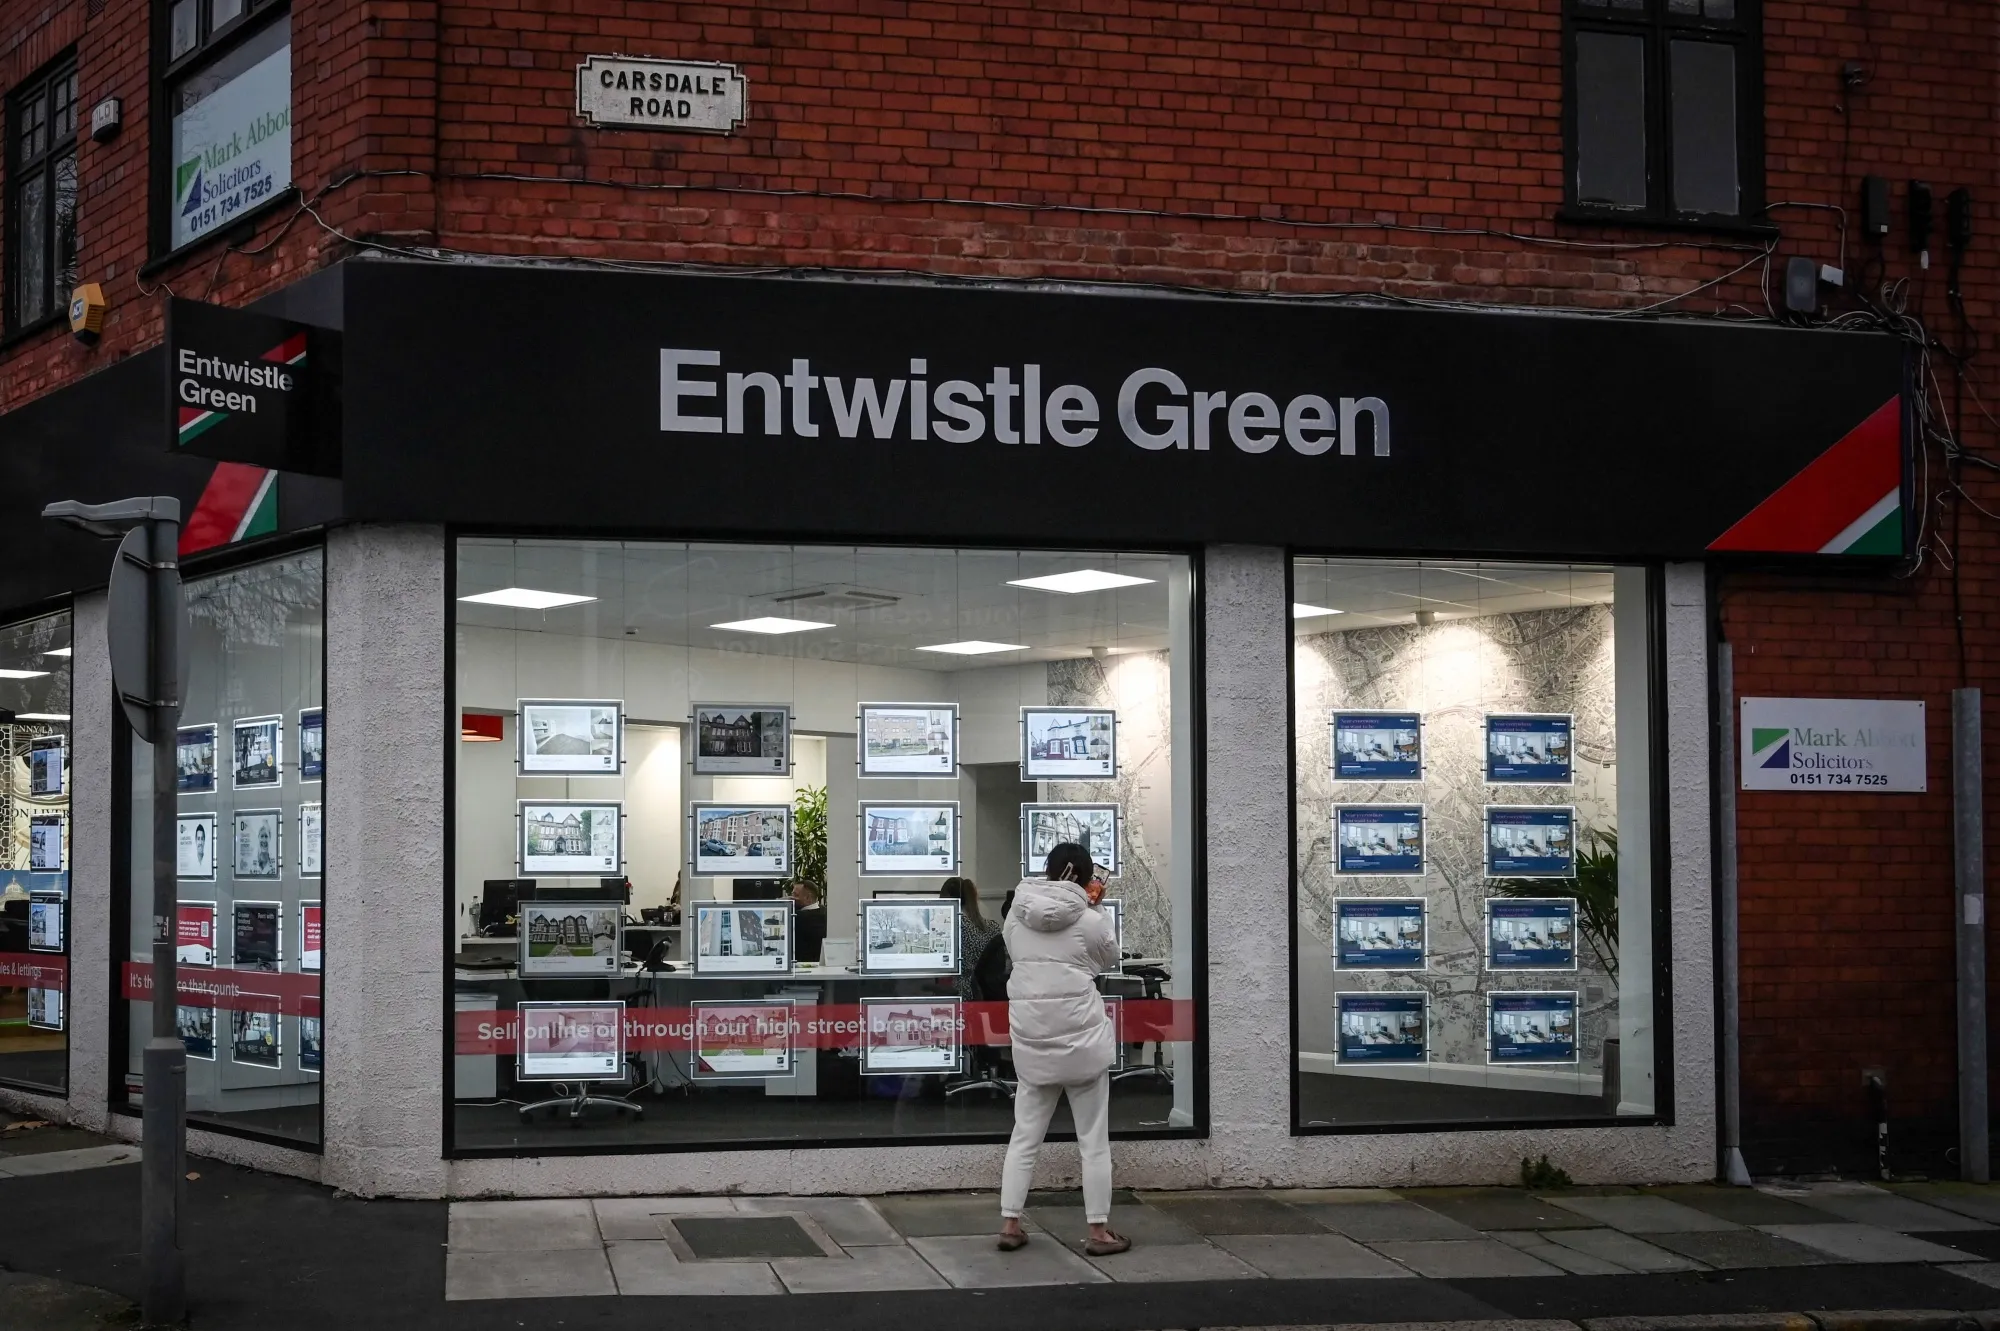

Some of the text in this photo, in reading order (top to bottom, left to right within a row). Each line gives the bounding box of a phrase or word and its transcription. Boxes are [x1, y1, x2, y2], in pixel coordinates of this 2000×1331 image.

[600, 69, 726, 96] CARSDALE
[630, 97, 692, 119] ROAD
[203, 131, 242, 174] Mark
[202, 159, 261, 205] Solicitors
[190, 174, 272, 232] 0151 734 7525
[179, 348, 293, 392] Entwistle
[179, 378, 256, 413] Green
[660, 348, 1390, 457] Entwistle Green
[1793, 727, 1847, 747] Mark
[1792, 752, 1873, 769] Solicitors
[1790, 773, 1888, 786] 0151 734 7525
[0, 961, 10, 975] les
[17, 962, 42, 980] lettings
[130, 973, 142, 988] It's
[144, 974, 154, 989] th
[188, 979, 207, 994] that
[208, 982, 240, 997] counts
[477, 1017, 966, 1041] Sell online or through our high street branches
